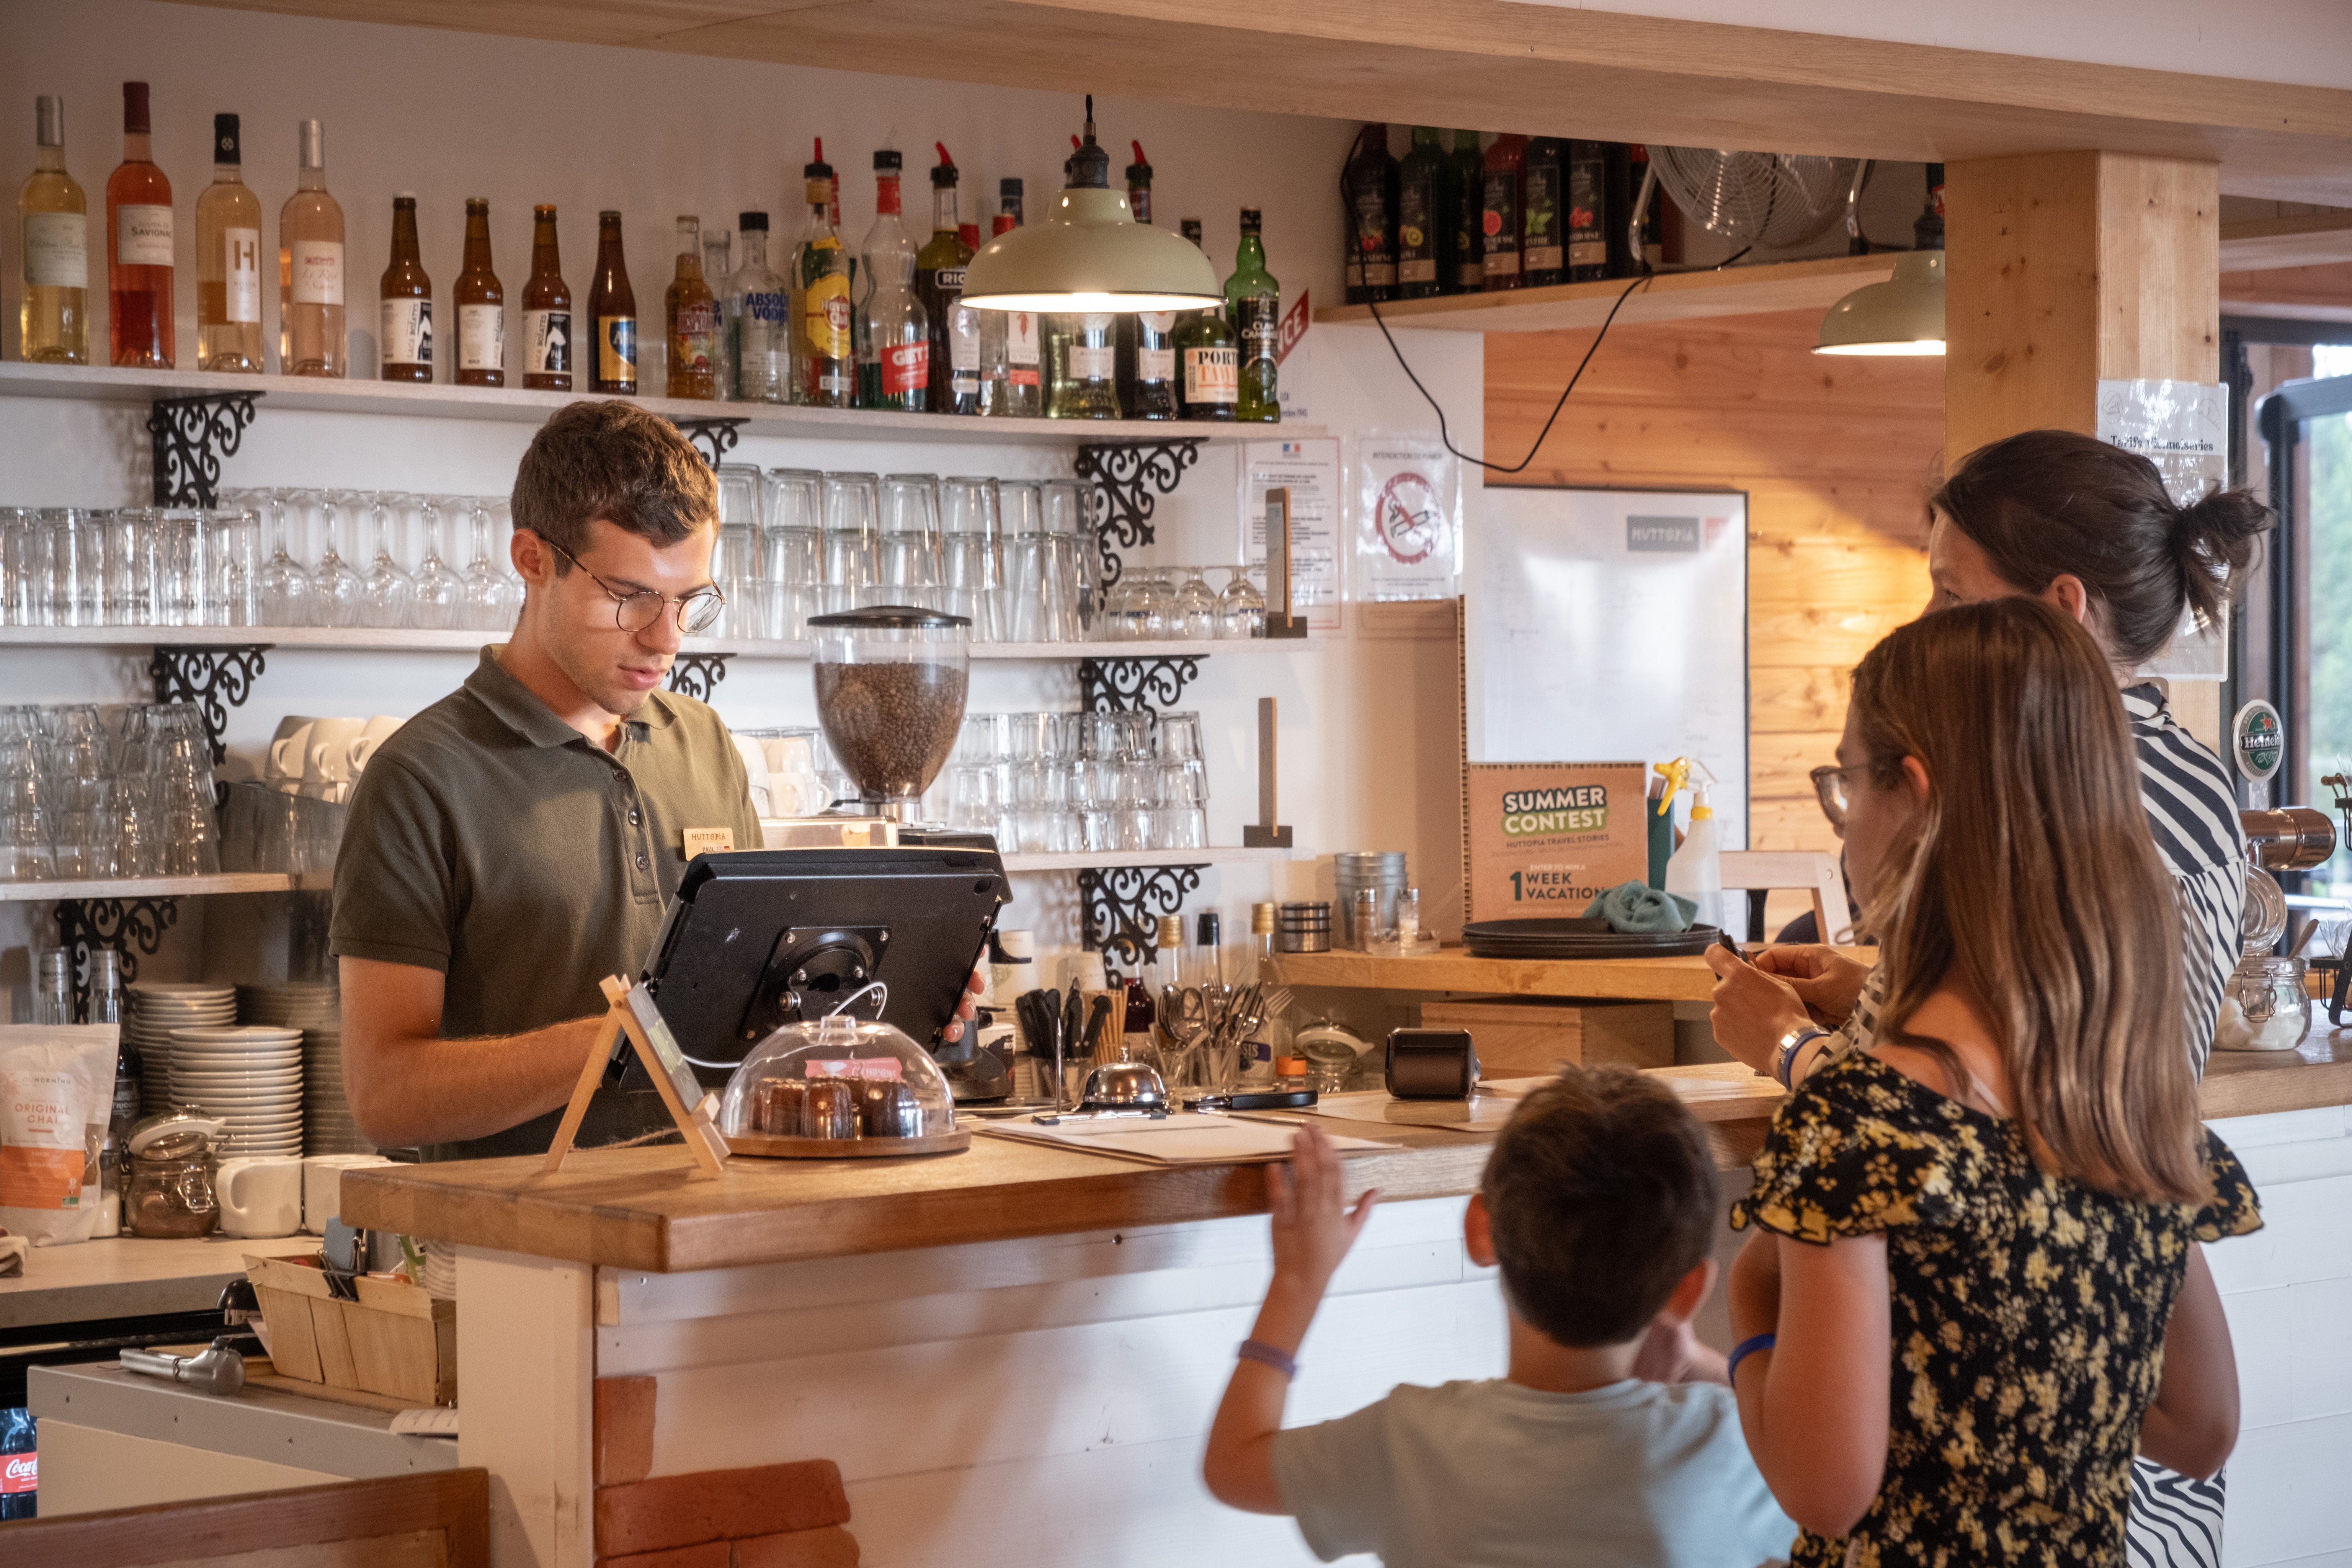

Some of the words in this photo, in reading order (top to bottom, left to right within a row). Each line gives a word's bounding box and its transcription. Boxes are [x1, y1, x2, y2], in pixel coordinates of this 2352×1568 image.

[943, 273, 965, 284] RIC
[2110, 435, 2143, 448] Tarifs
[1504, 787, 1604, 812] SUMMER
[1505, 809, 1605, 833] CONTEST
[692, 833, 725, 841] HUTTOPIA
[1506, 840, 1545, 849] HUTTOPIA
[1547, 837, 1576, 846] TRAVEL
[1578, 834, 1610, 843] STORIES
[1526, 872, 1572, 884] WEEK
[1510, 871, 1522, 901] 1
[1243, 1043, 1259, 1057] SIS
[15, 1103, 70, 1115] ORIGINAL
